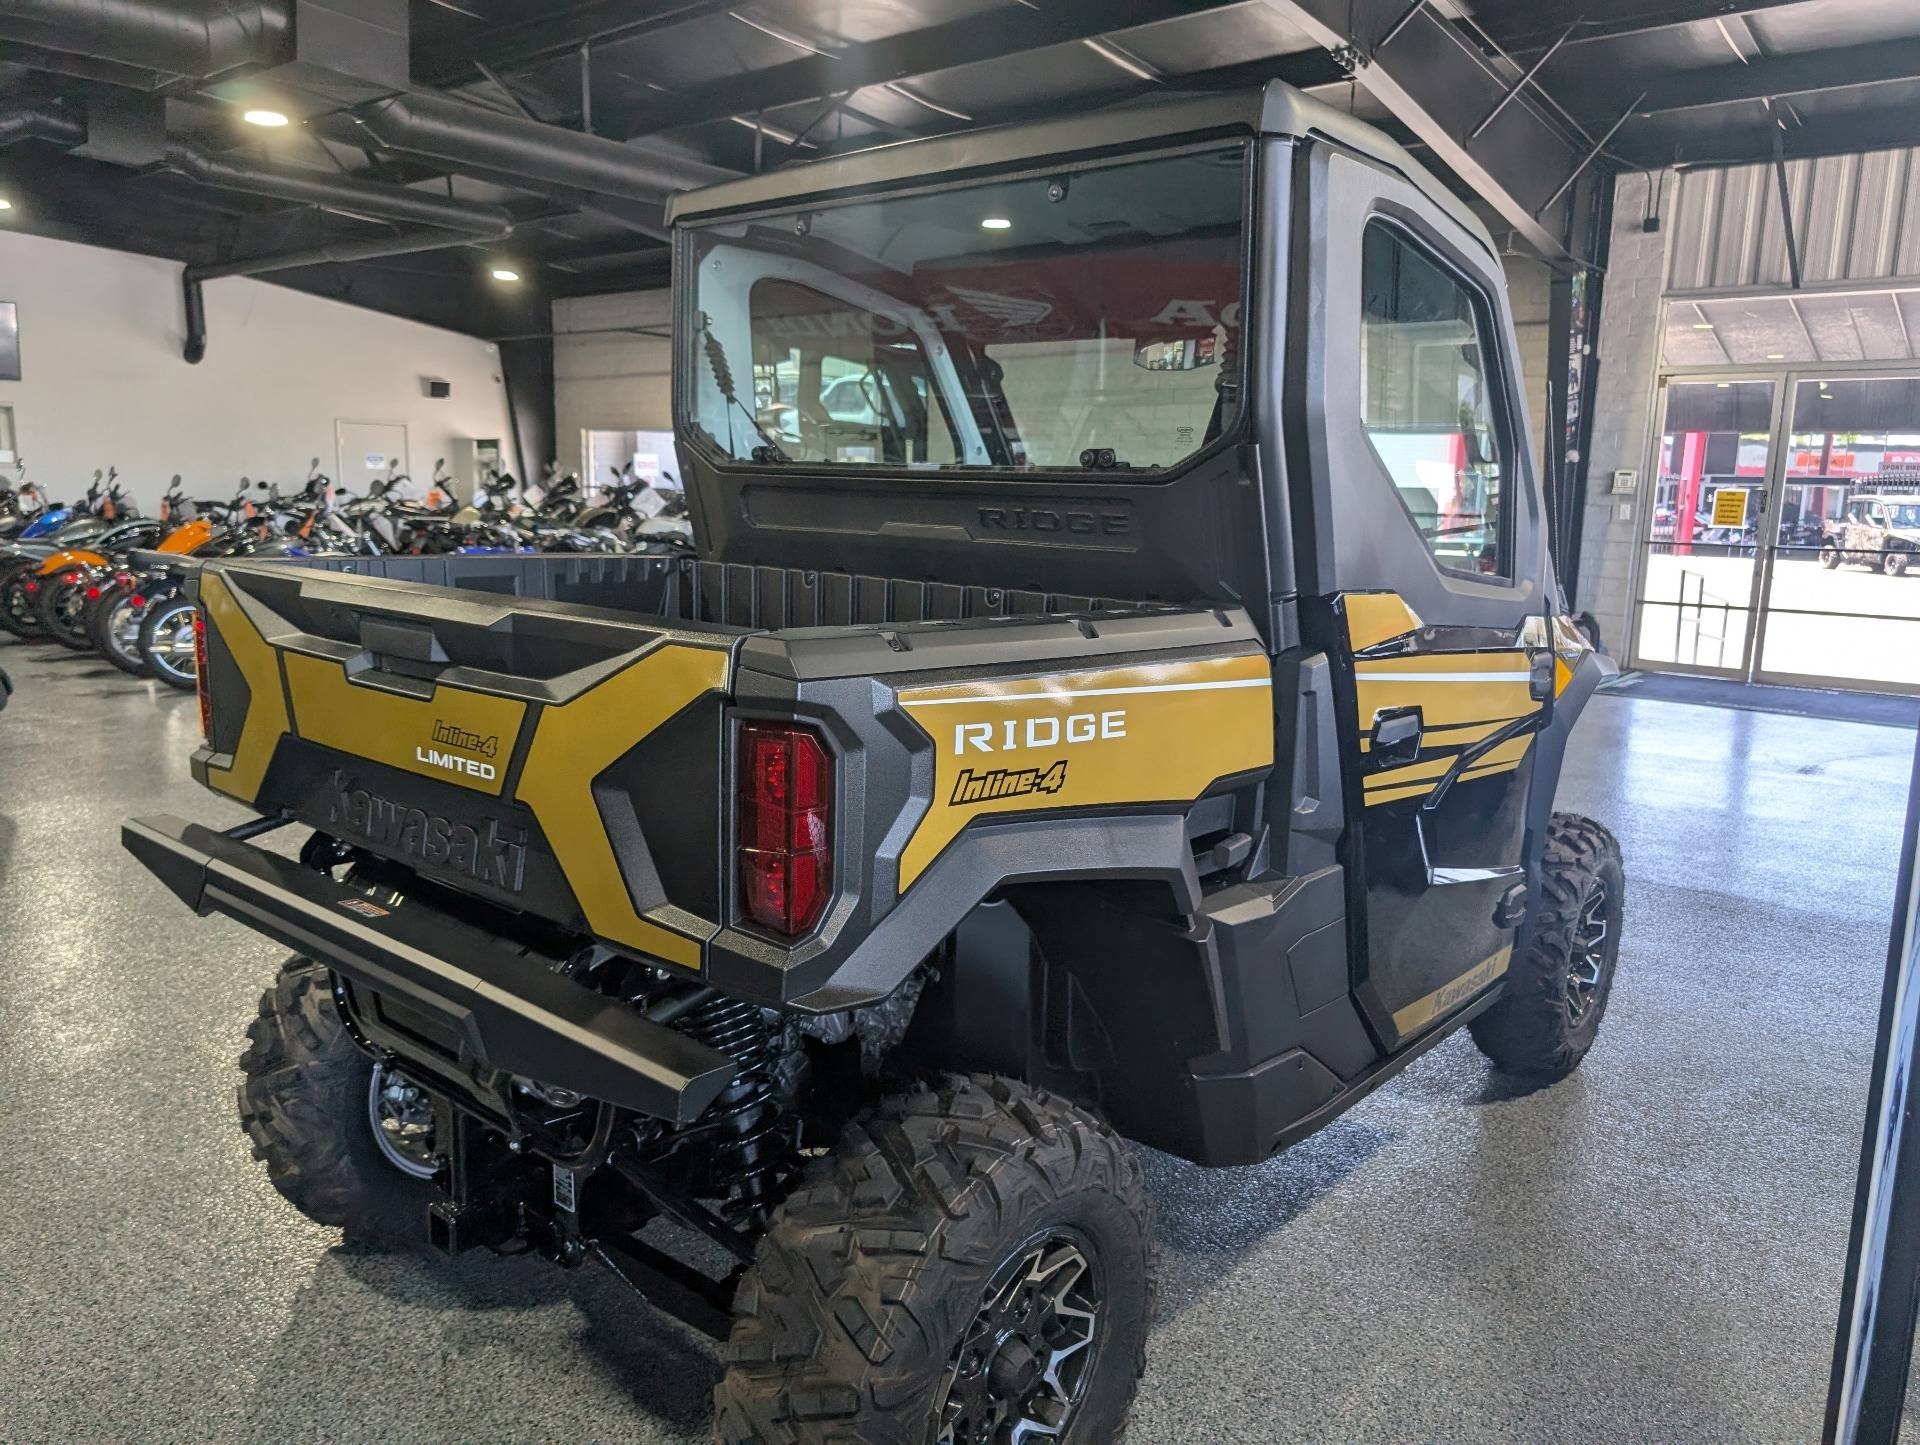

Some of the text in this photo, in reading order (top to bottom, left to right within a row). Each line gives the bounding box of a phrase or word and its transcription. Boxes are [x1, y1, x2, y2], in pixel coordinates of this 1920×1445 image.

[977, 507, 1130, 535] RIDGE
[432, 719, 499, 758] Inline-4
[954, 710, 1127, 755] RIDGE
[416, 746, 496, 780] LIMITED
[948, 759, 1069, 807] Inline-4
[328, 769, 528, 892] Kawasaki
